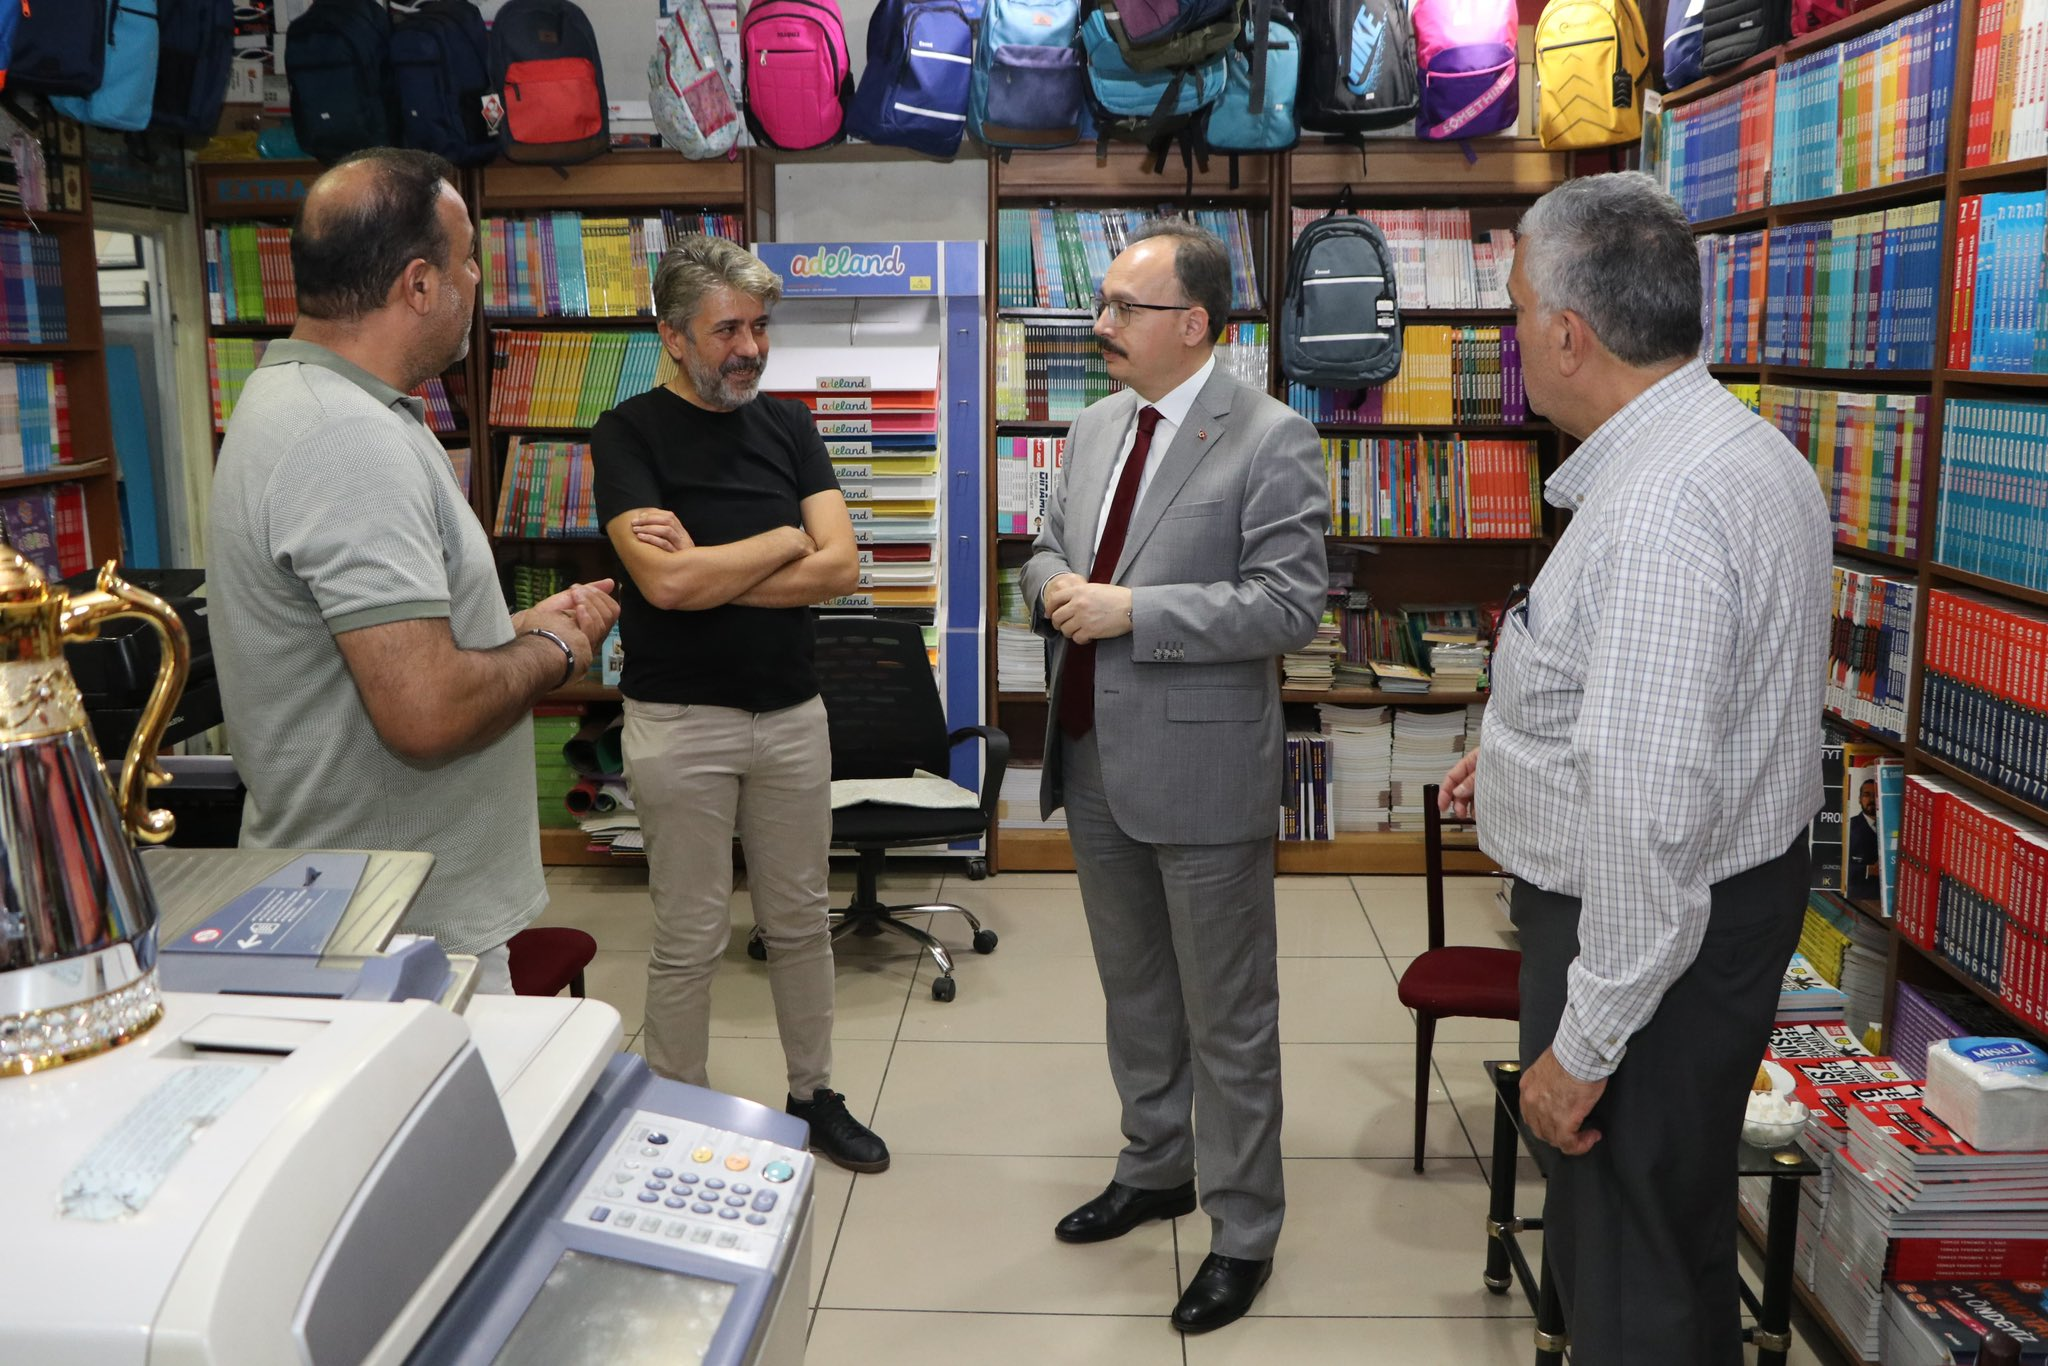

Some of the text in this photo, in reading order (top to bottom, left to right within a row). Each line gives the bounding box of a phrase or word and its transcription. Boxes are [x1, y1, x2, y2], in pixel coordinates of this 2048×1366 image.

[1349, 4, 1383, 84] NIKE
[791, 245, 905, 277] adeland
[821, 378, 866, 388] adeland
[822, 400, 867, 411] adeland
[822, 424, 868, 433] adeland
[829, 446, 867, 455] deland
[834, 468, 868, 477] eland
[842, 489, 868, 499] land
[1821, 750, 1841, 760] TYT
[1770, 1037, 1807, 1058] SIN
[1811, 1071, 1842, 1083] SI
[1825, 1062, 1859, 1083] FENO
